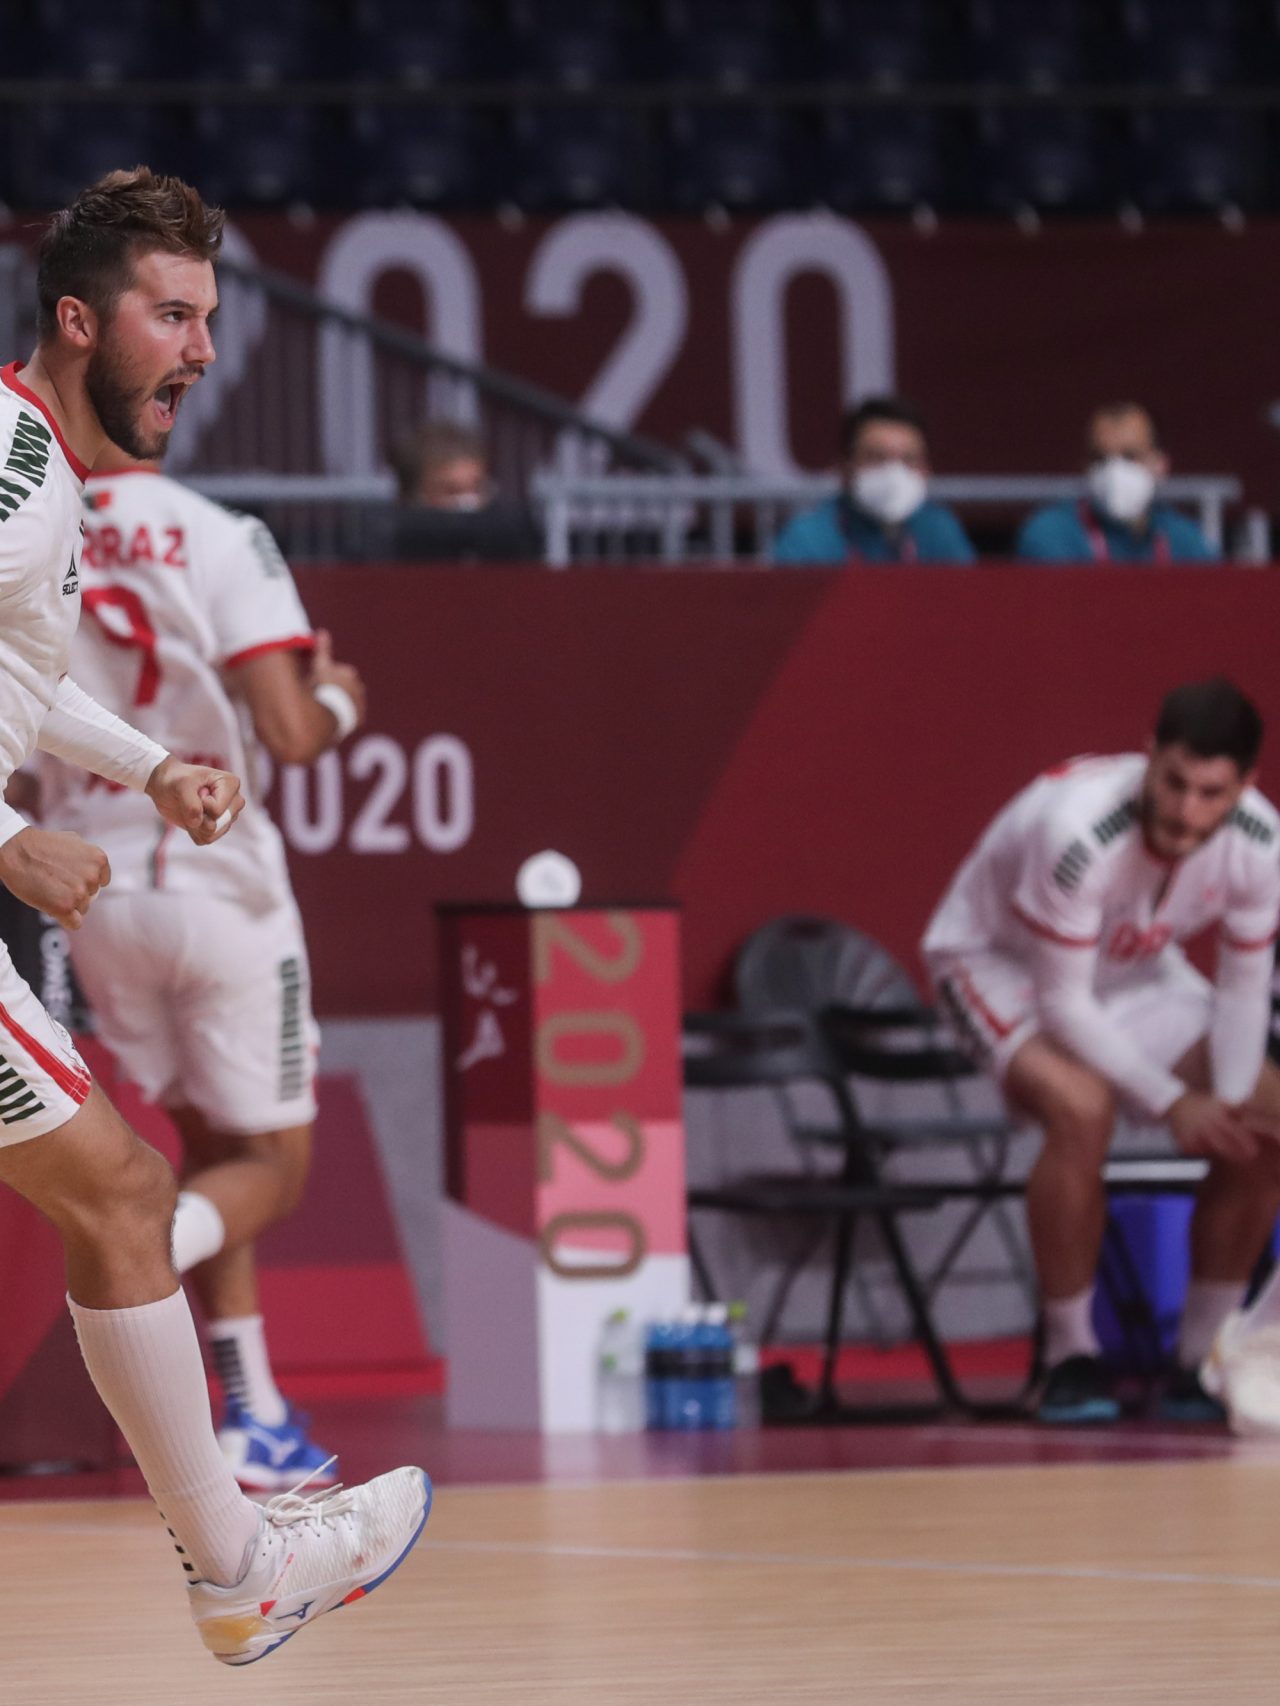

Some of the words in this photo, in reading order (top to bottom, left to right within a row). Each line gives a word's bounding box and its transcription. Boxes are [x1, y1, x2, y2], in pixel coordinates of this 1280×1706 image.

[82, 521, 186, 569] RRAZ
[81, 582, 162, 708] 9
[256, 732, 476, 855] 020
[532, 912, 647, 1281] 2020
